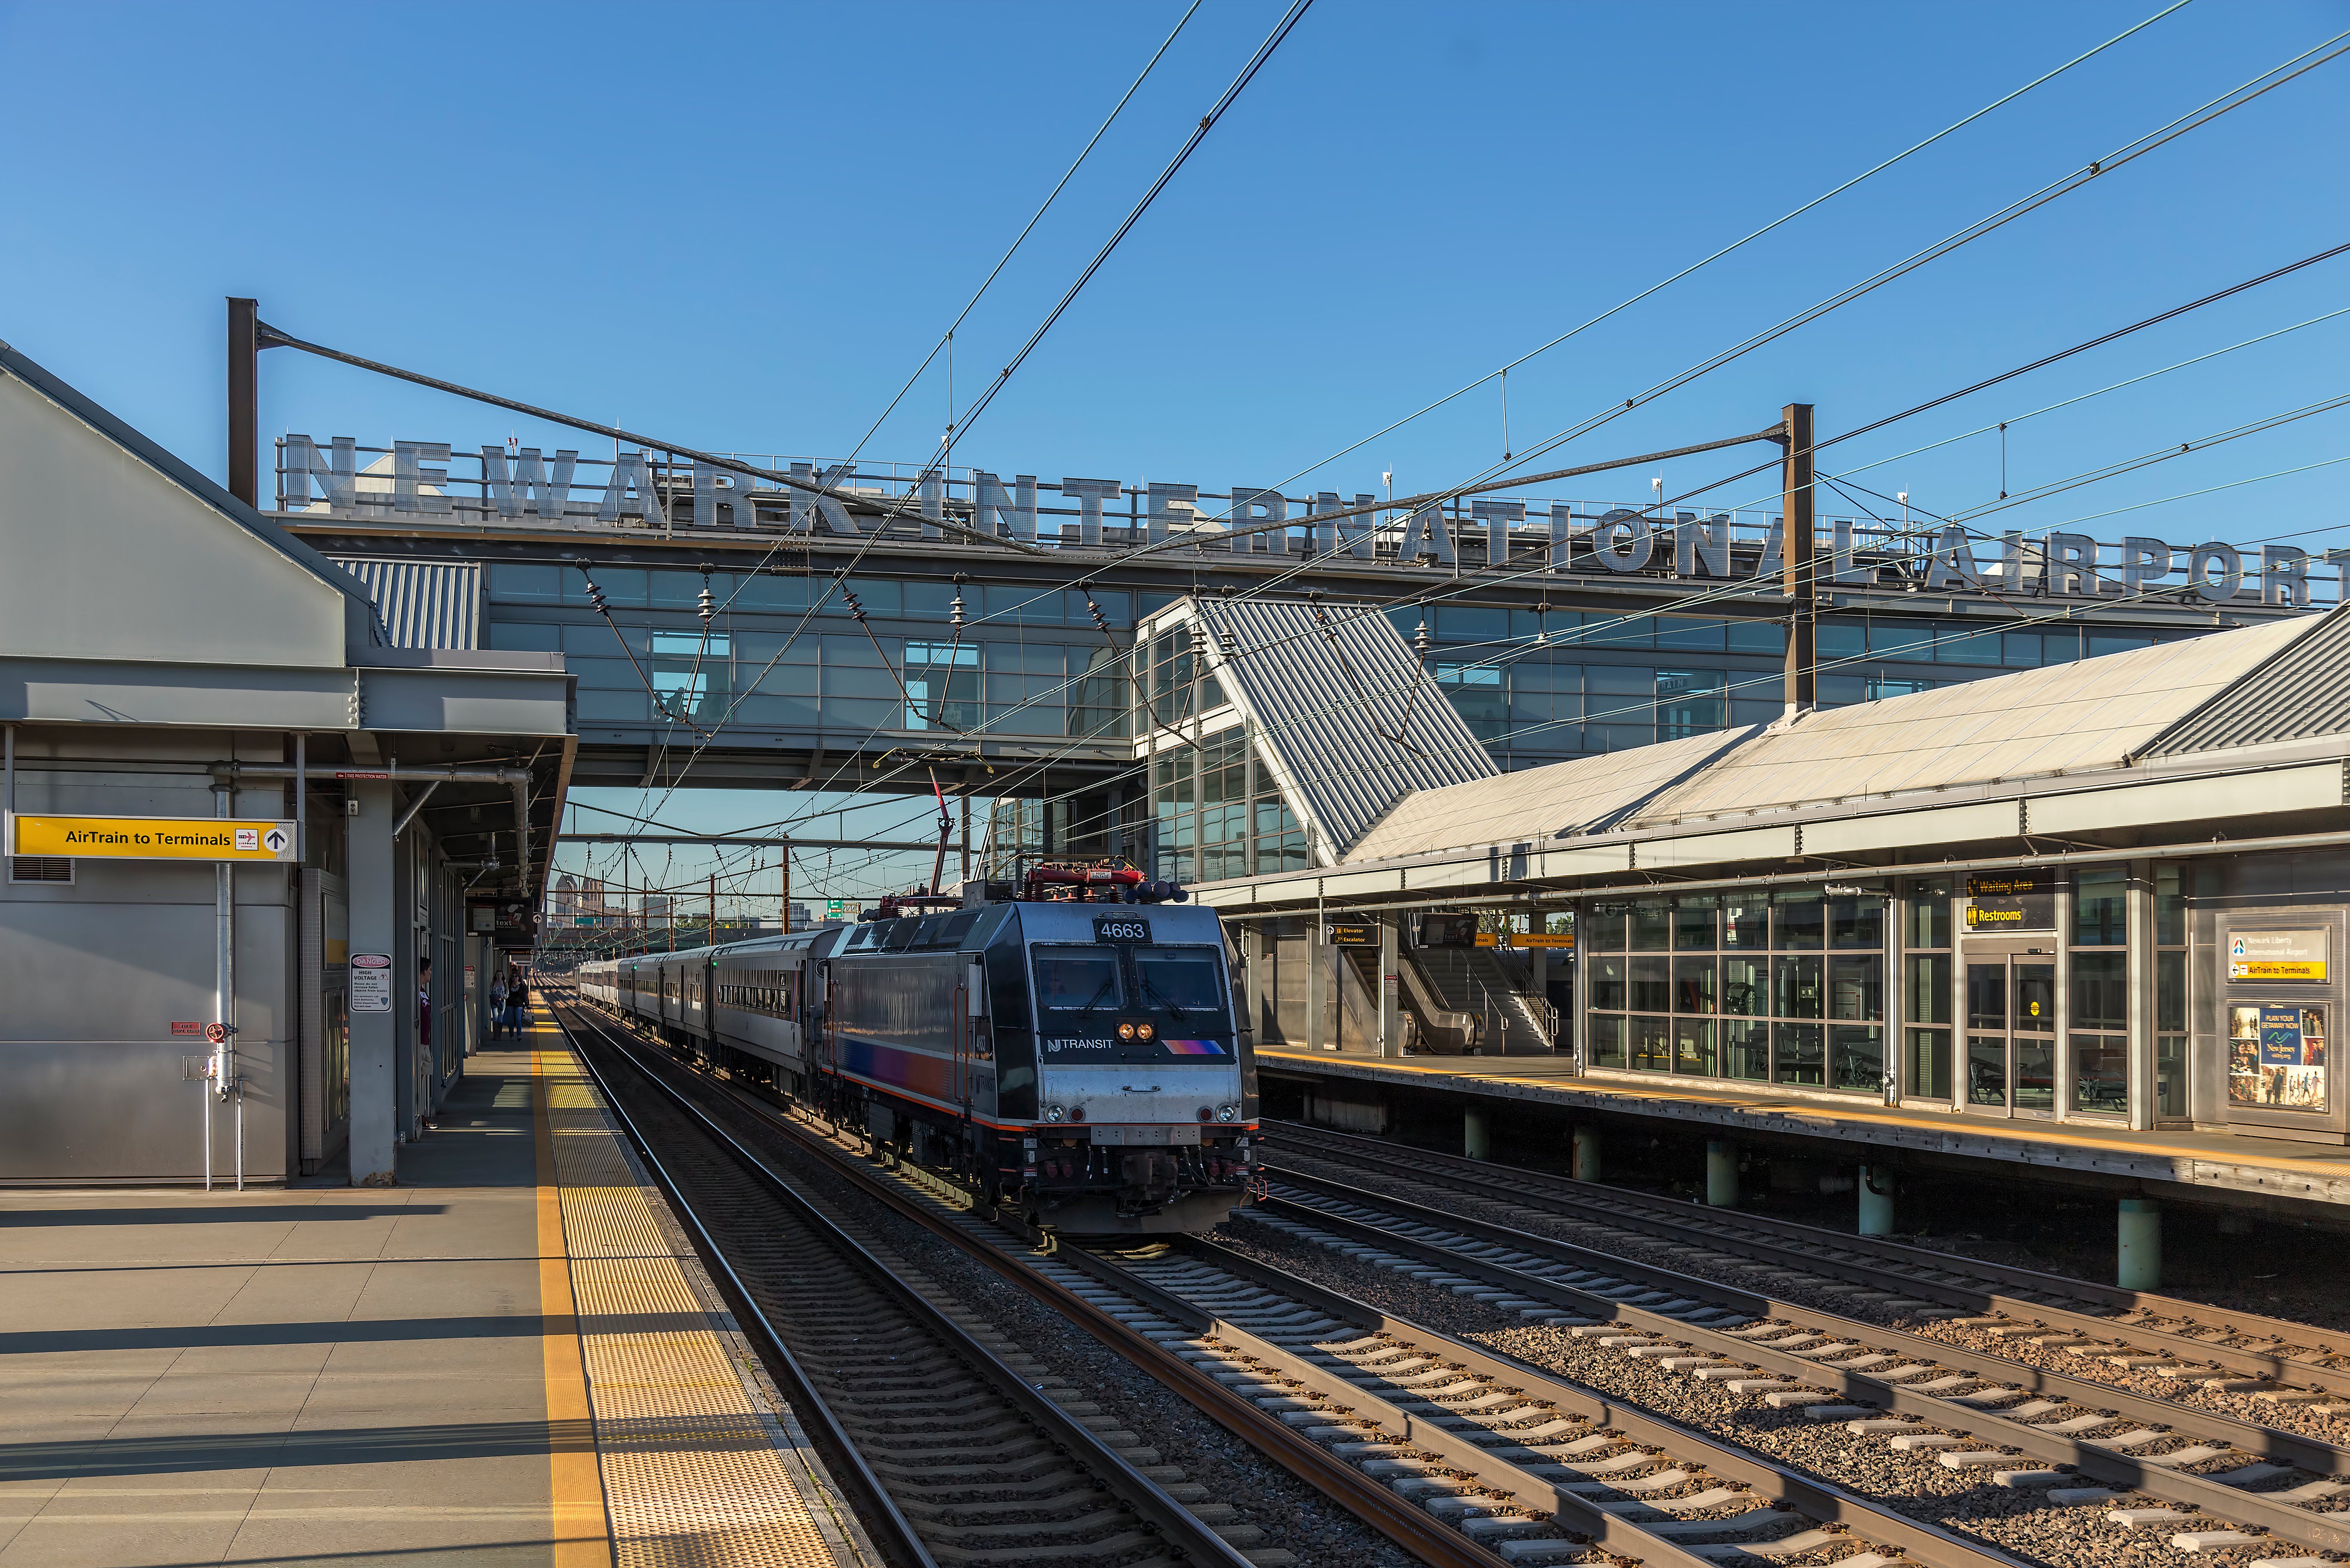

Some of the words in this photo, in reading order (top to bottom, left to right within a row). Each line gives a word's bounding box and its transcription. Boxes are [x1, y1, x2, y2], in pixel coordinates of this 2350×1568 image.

[287, 434, 861, 533] NEWARK
[65, 831, 128, 843] AirTrain
[134, 832, 150, 844] to
[155, 833, 231, 846] Terminals
[1979, 880, 2012, 895] Waiting
[2013, 879, 2033, 890] Area
[1979, 909, 2022, 922] Restrooms
[1101, 923, 1145, 938] 4663
[2247, 936, 2270, 944] Newark
[2272, 936, 2292, 946] Liberty
[2286, 948, 2308, 957] Airport
[1047, 1039, 1061, 1052] NJ
[1061, 1039, 1114, 1049] TRANSIT
[2266, 1043, 2279, 1052] New
[2278, 1044, 2295, 1054] Jersey
